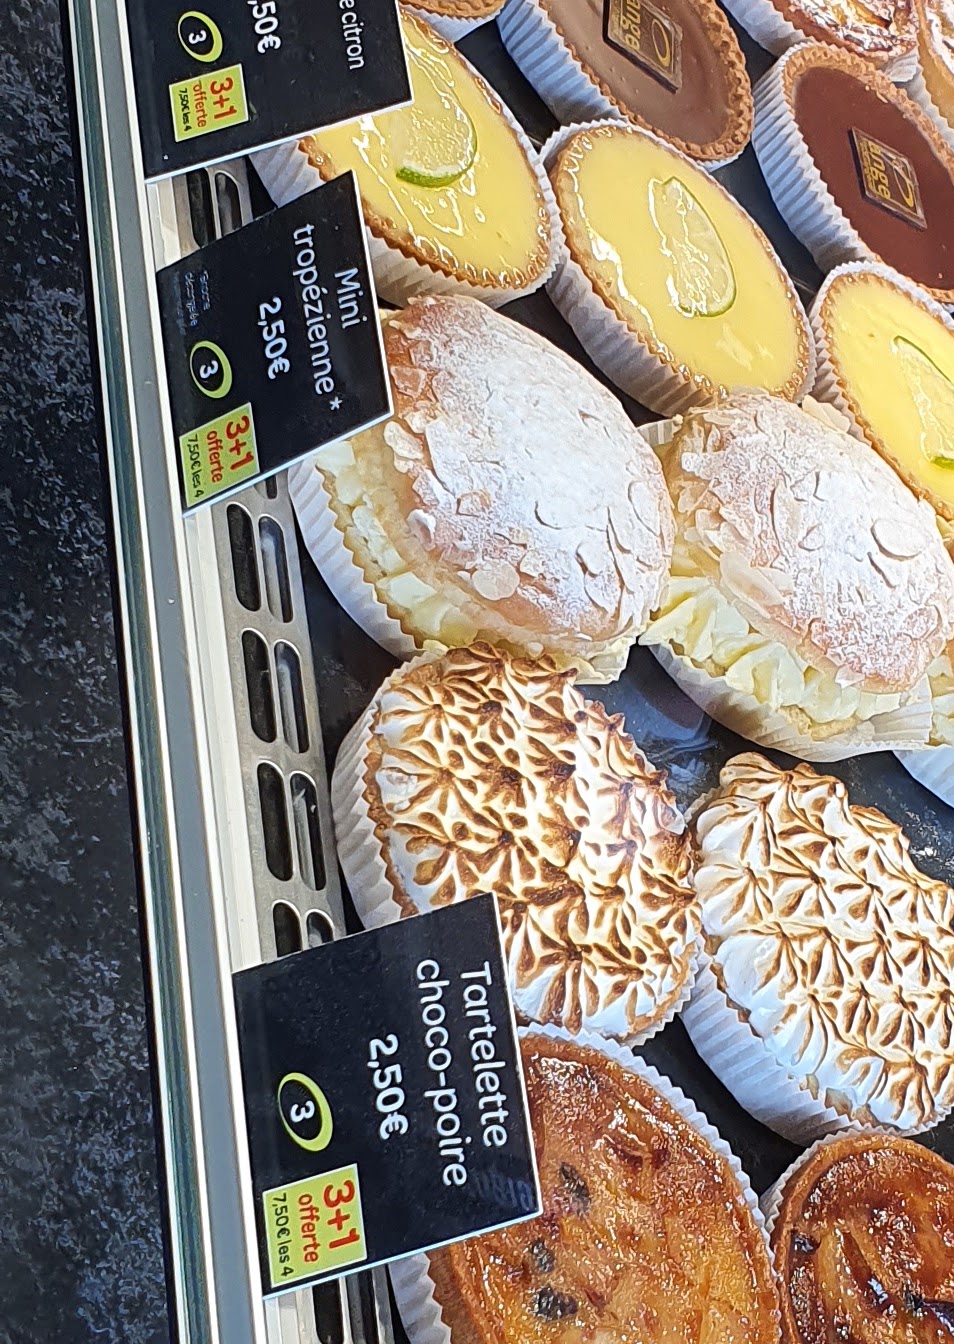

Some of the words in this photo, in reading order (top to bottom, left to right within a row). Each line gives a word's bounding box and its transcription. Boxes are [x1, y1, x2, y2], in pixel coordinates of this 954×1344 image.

[188, 30, 207, 44] 3
[341, 10, 365, 69] citron
[192, 83, 207, 128] offerte
[210, 77, 237, 120] 3+1
[334, 267, 368, 330] Mini
[258, 296, 291, 380] 2,50€
[200, 360, 219, 379] 3
[206, 430, 223, 483] offerte
[226, 415, 254, 471] 3+1
[194, 489, 205, 499] 4
[415, 959, 472, 1186] choco-poire
[460, 961, 509, 1147] Tartelette
[289, 1101, 315, 1122] 3
[368, 1034, 409, 1140] 2,50€
[270, 1192, 290, 1240] 7,50€
[298, 1194, 321, 1263] offerte
[322, 1180, 361, 1249] 3+1
[276, 1238, 292, 1265] les
[280, 1267, 294, 1277] 4
